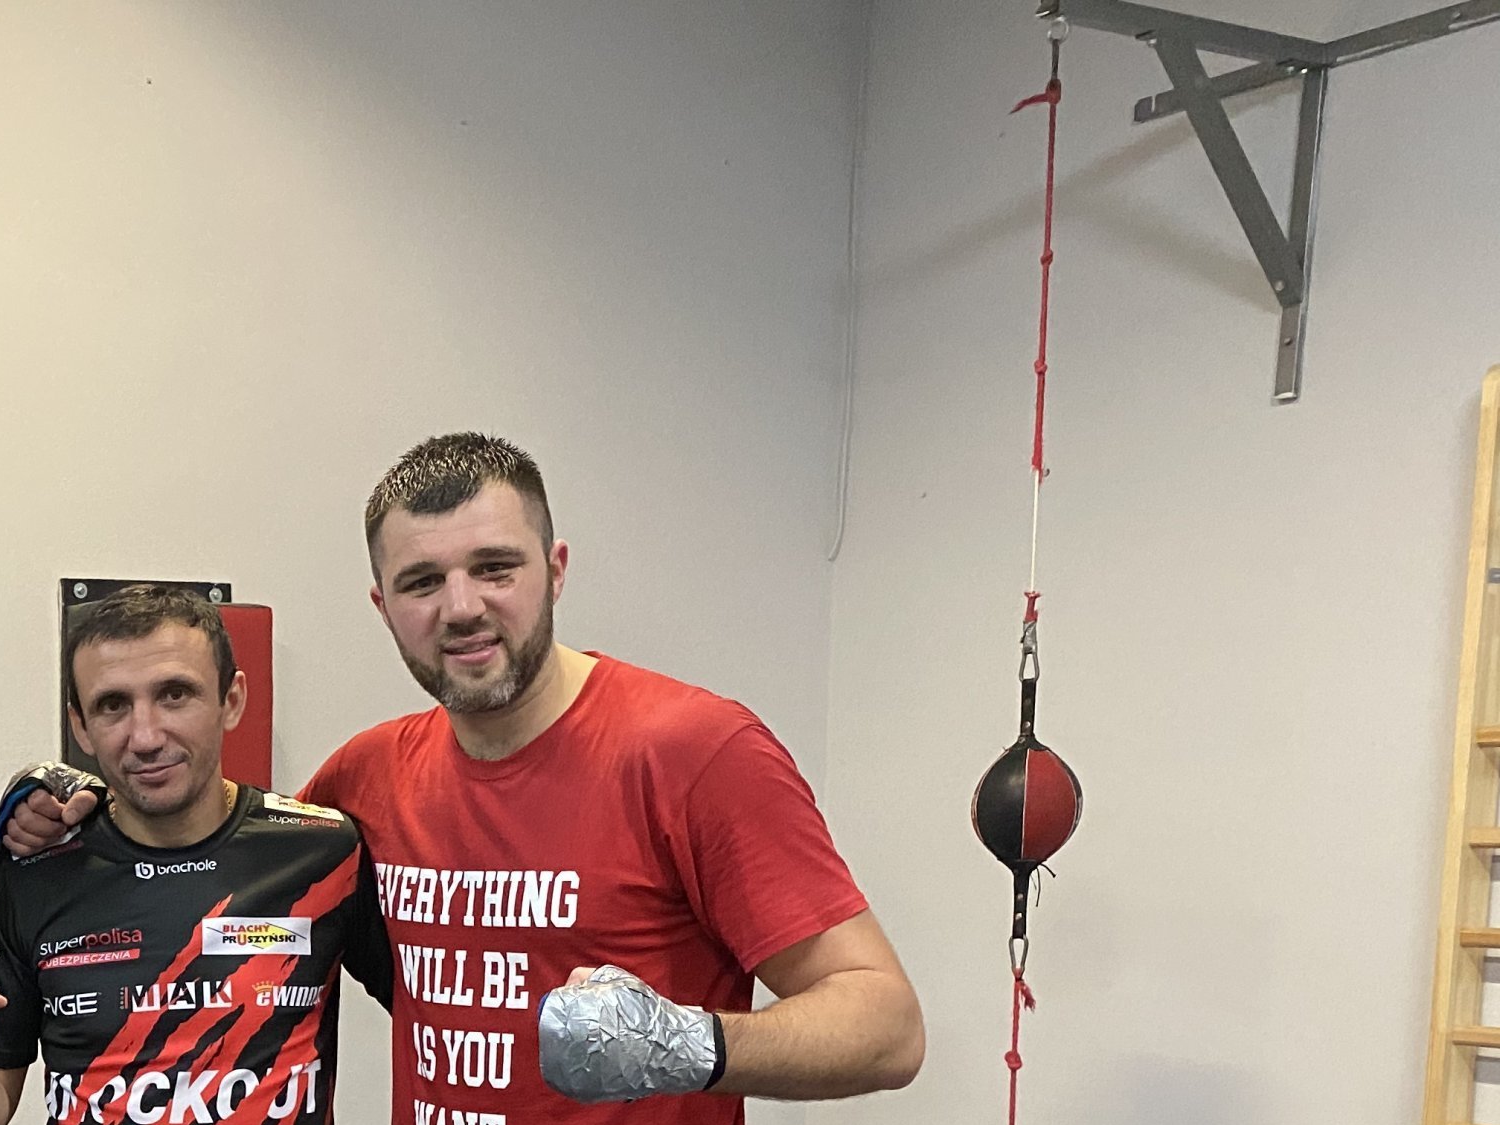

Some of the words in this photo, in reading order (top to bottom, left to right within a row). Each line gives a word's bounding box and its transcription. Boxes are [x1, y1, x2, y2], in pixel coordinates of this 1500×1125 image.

[268, 815, 340, 829] superpolisa
[156, 859, 217, 876] brachole
[375, 863, 580, 928] EVERYTHING
[222, 924, 270, 933] BLACHY
[222, 933, 296, 945] PRUSZYŃSKI
[44, 949, 132, 968] UBEZPIECZENIA
[398, 944, 474, 1006] WILL
[481, 951, 529, 1009] BE
[130, 981, 232, 1013] MAK
[413, 1022, 437, 1081] IS
[442, 1030, 514, 1089] YOU
